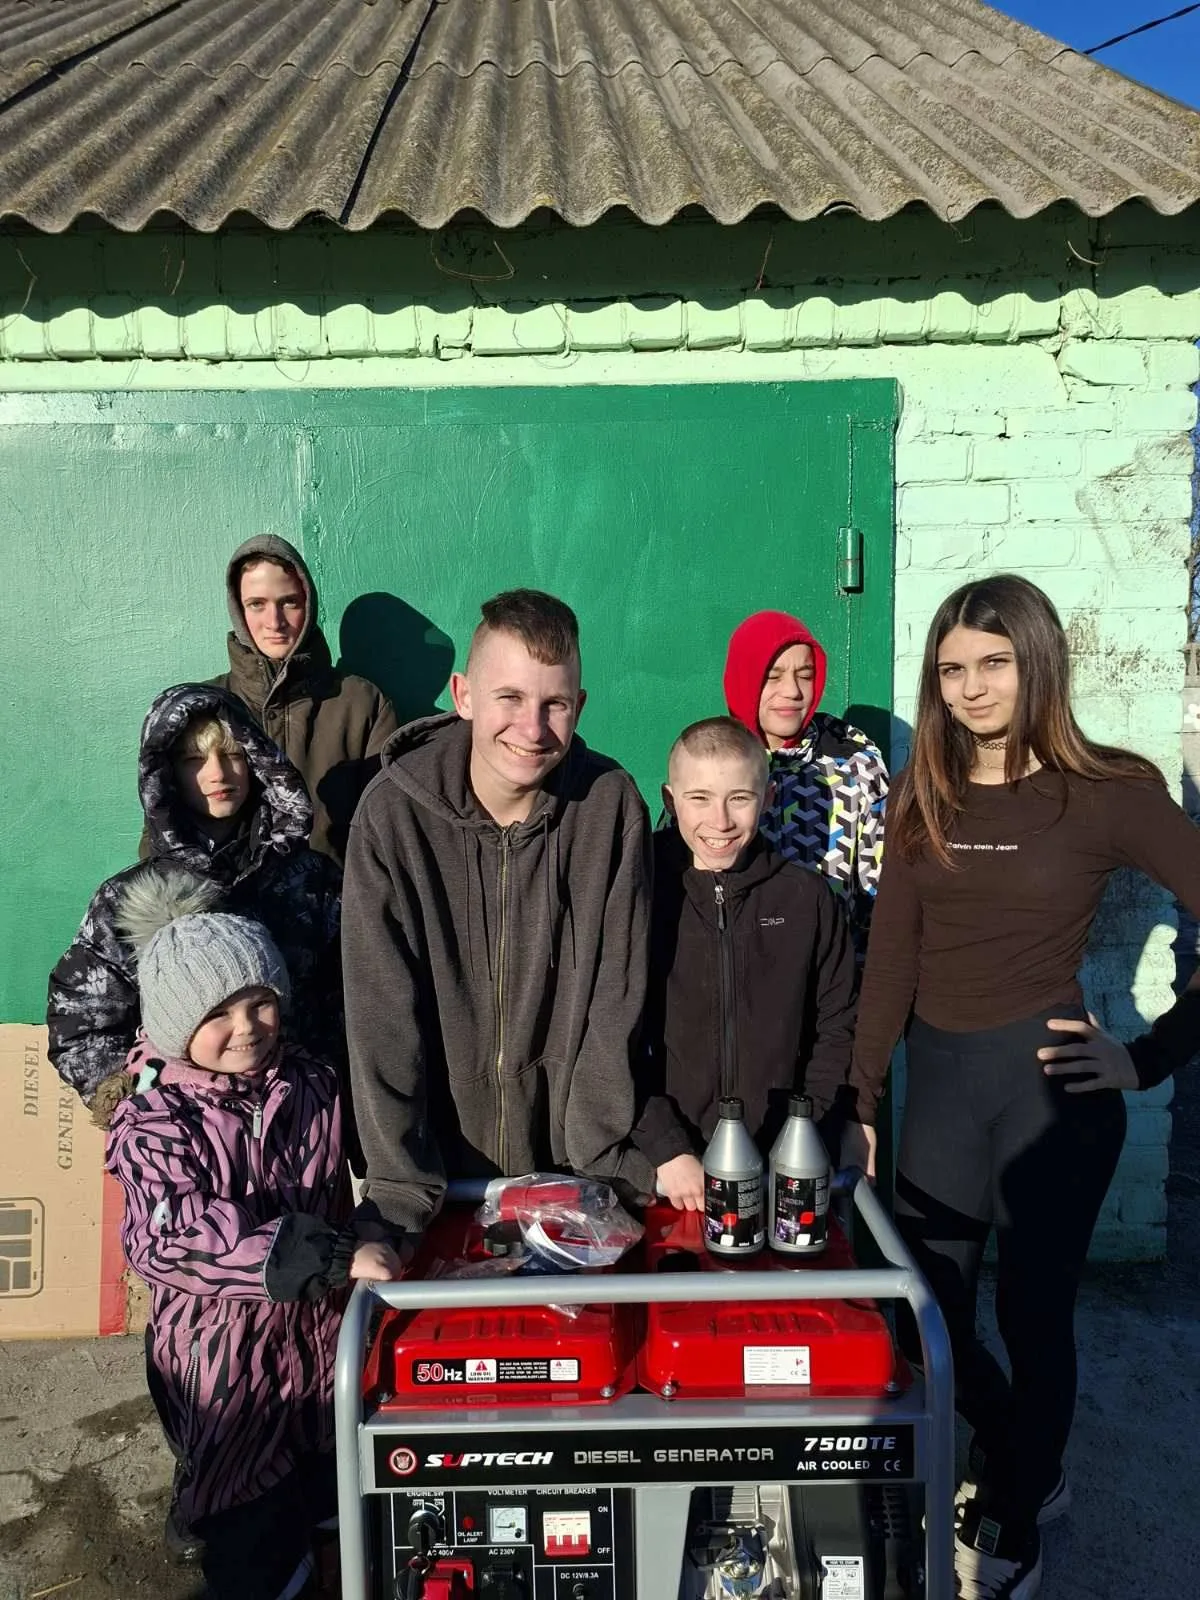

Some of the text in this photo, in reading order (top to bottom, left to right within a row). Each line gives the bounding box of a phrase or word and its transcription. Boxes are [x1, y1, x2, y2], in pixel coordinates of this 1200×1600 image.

[23, 1040, 40, 1117] DIESEL
[57, 1080, 74, 1170] GENERA
[417, 1363, 463, 1382] 50Hz
[804, 1436, 896, 1451] 7500TE
[424, 1447, 774, 1468] SUPTECH DIESEL GENERATOR
[797, 1460, 870, 1471] AIR COOLED
[487, 1488, 528, 1496] VOLTMETER
[536, 1487, 597, 1495] CIRCUIT BREAKER
